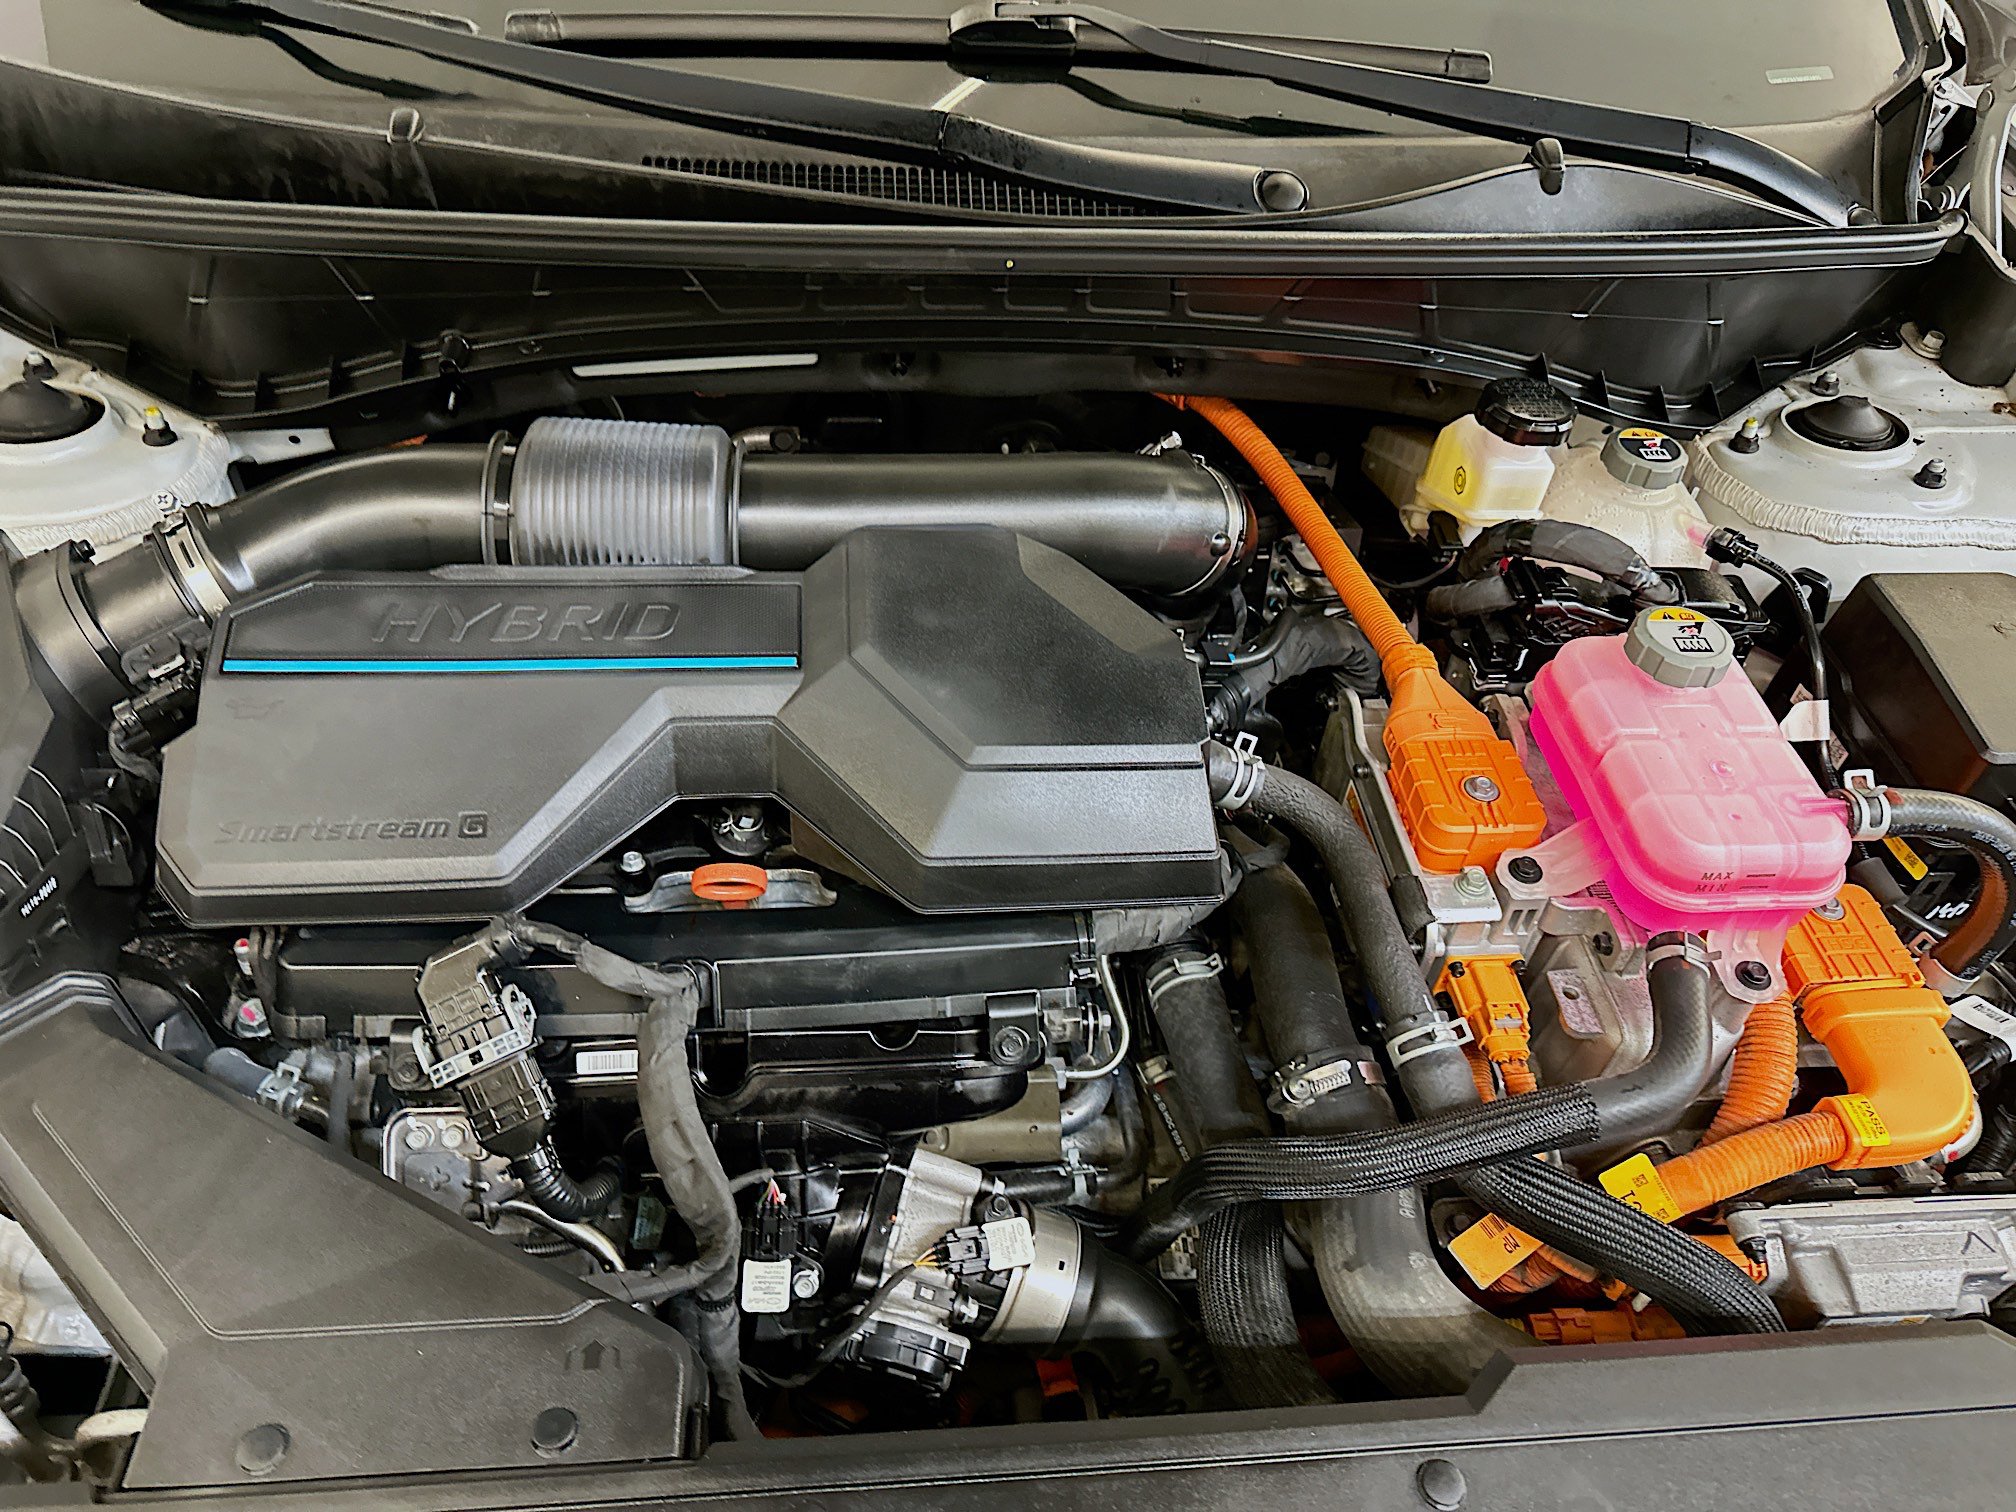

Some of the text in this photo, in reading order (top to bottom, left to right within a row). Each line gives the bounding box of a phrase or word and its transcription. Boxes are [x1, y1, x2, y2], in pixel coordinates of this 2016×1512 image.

[371, 602, 682, 642] HYBRID
[213, 810, 488, 843] Smartstream G
[1694, 883, 1727, 892] MIN
[1700, 871, 1734, 881] MAX
[1860, 1101, 1886, 1135] PASS
